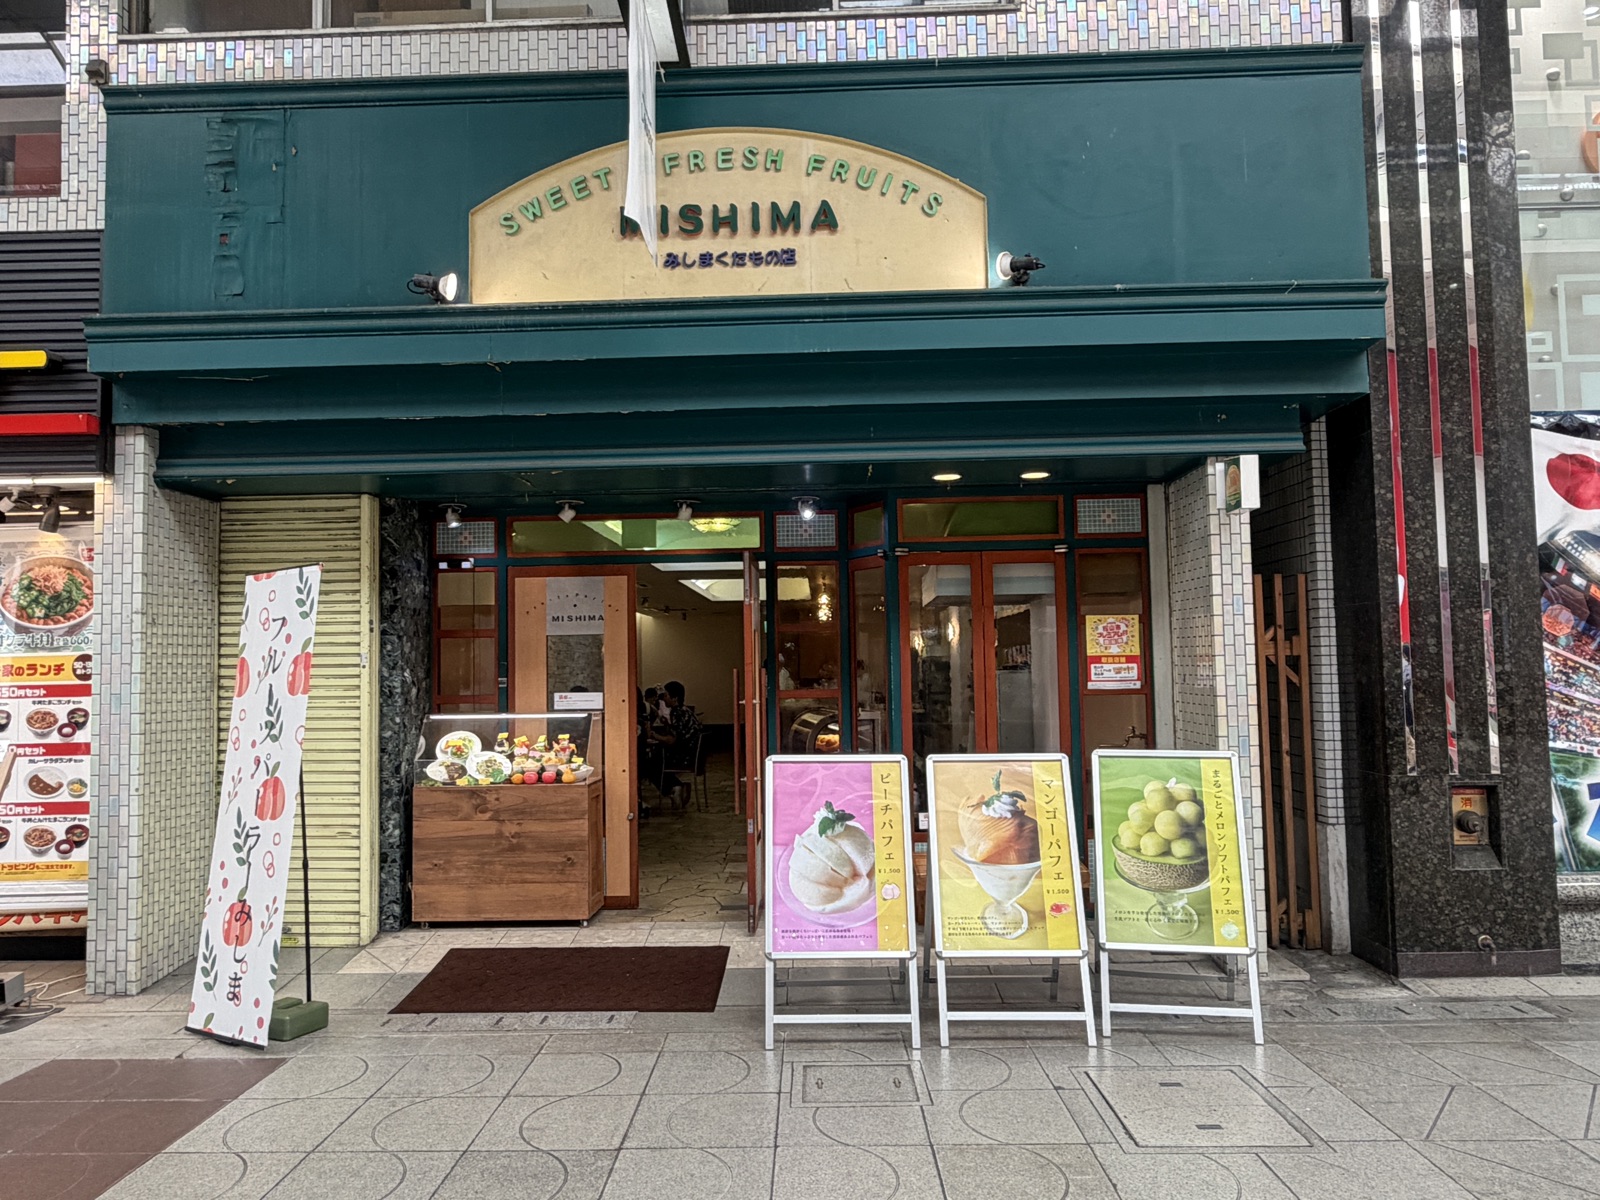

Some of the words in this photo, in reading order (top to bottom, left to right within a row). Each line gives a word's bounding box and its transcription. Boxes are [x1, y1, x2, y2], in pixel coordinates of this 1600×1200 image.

[499, 165, 612, 237] SWEET
[662, 146, 785, 176] FRESH
[806, 153, 944, 217] FRUITS
[551, 614, 605, 622] MISHIMA
[0, 662, 65, 677] 家のランチ
[880, 772, 895, 861] ピーチパフェ
[1041, 778, 1065, 881] マンゴーパフェ
[1211, 769, 1233, 906] まるごとメロンソフトパフェ
